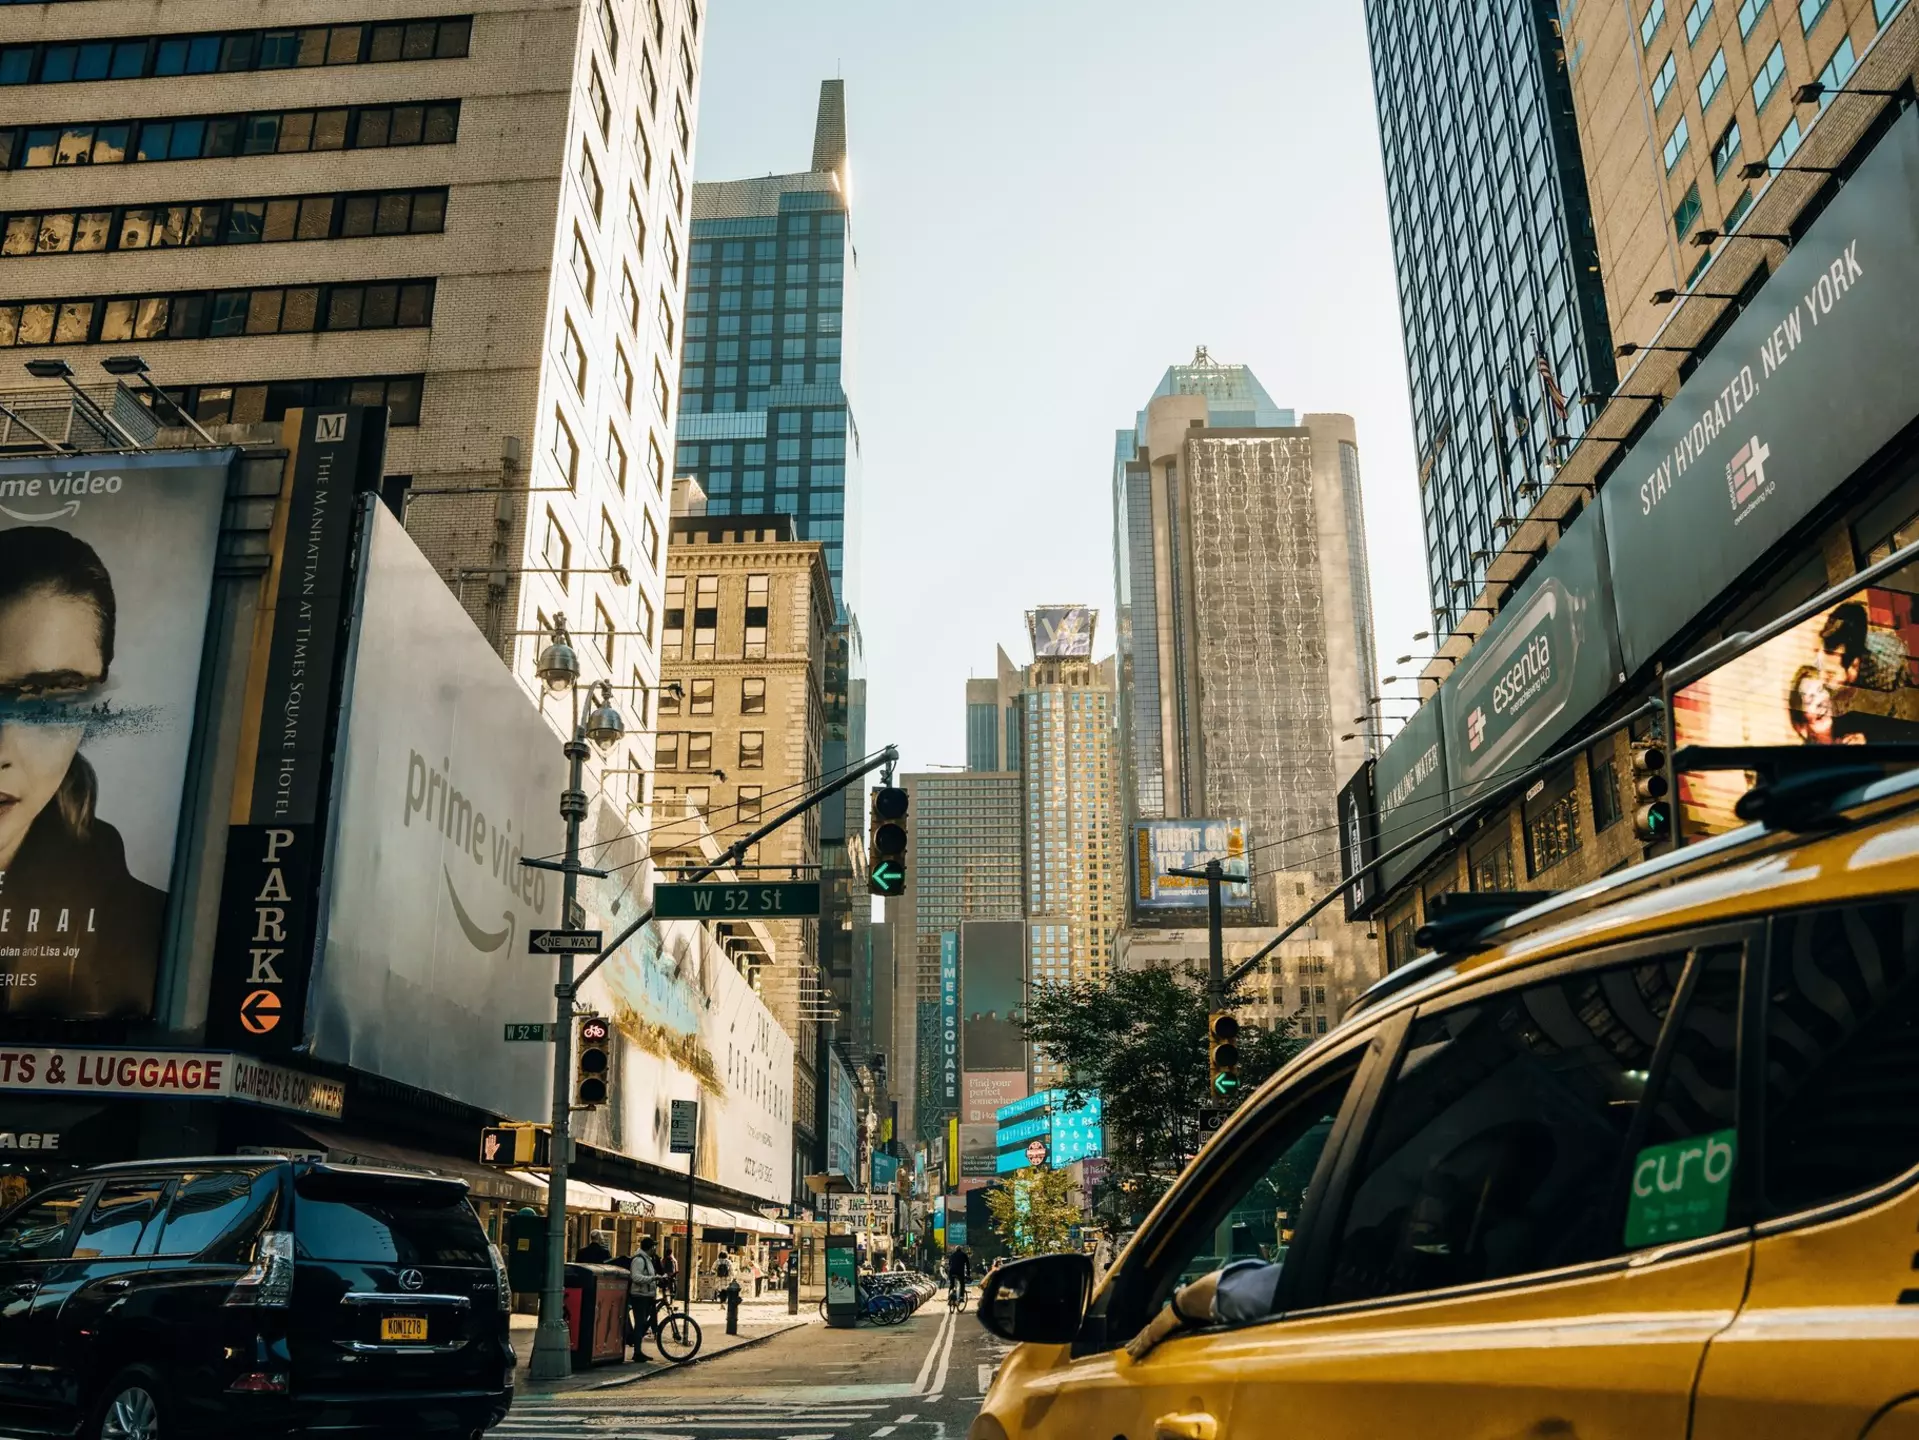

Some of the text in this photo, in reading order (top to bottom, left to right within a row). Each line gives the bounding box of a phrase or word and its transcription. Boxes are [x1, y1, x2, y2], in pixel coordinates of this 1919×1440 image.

[1640, 238, 1863, 516] STAY HYDRATED, NEW YORK
[319, 416, 345, 439] M
[48, 470, 123, 496] video
[274, 451, 334, 818] THE MANHATTAN AT TIMES SQUARE HOTEL
[1493, 635, 1550, 714] essentia
[1510, 681, 1541, 716] overachieving
[1386, 766, 1416, 818] ALKALINE
[403, 748, 546, 916] prime video
[1156, 827, 1201, 851] HURT
[1156, 851, 1186, 874] THE
[246, 829, 295, 984] PARK
[693, 889, 783, 911] W 52 St
[22, 946, 38, 957] and
[40, 946, 61, 957] Lisa
[63, 946, 80, 959] Joy
[540, 937, 593, 947] ONE WAY
[507, 1025, 542, 1040] W 52 ST
[943, 940, 956, 1097] TIMES SQUARE
[0, 1053, 223, 1091] TS & LUGGAGE
[234, 1062, 281, 1101] CAMERAS
[282, 1075, 290, 1100] &
[969, 1078, 1012, 1090] Find your
[969, 1087, 1001, 1097] perfect
[0, 1133, 60, 1150] AGE
[1633, 1137, 1733, 1197] curb
